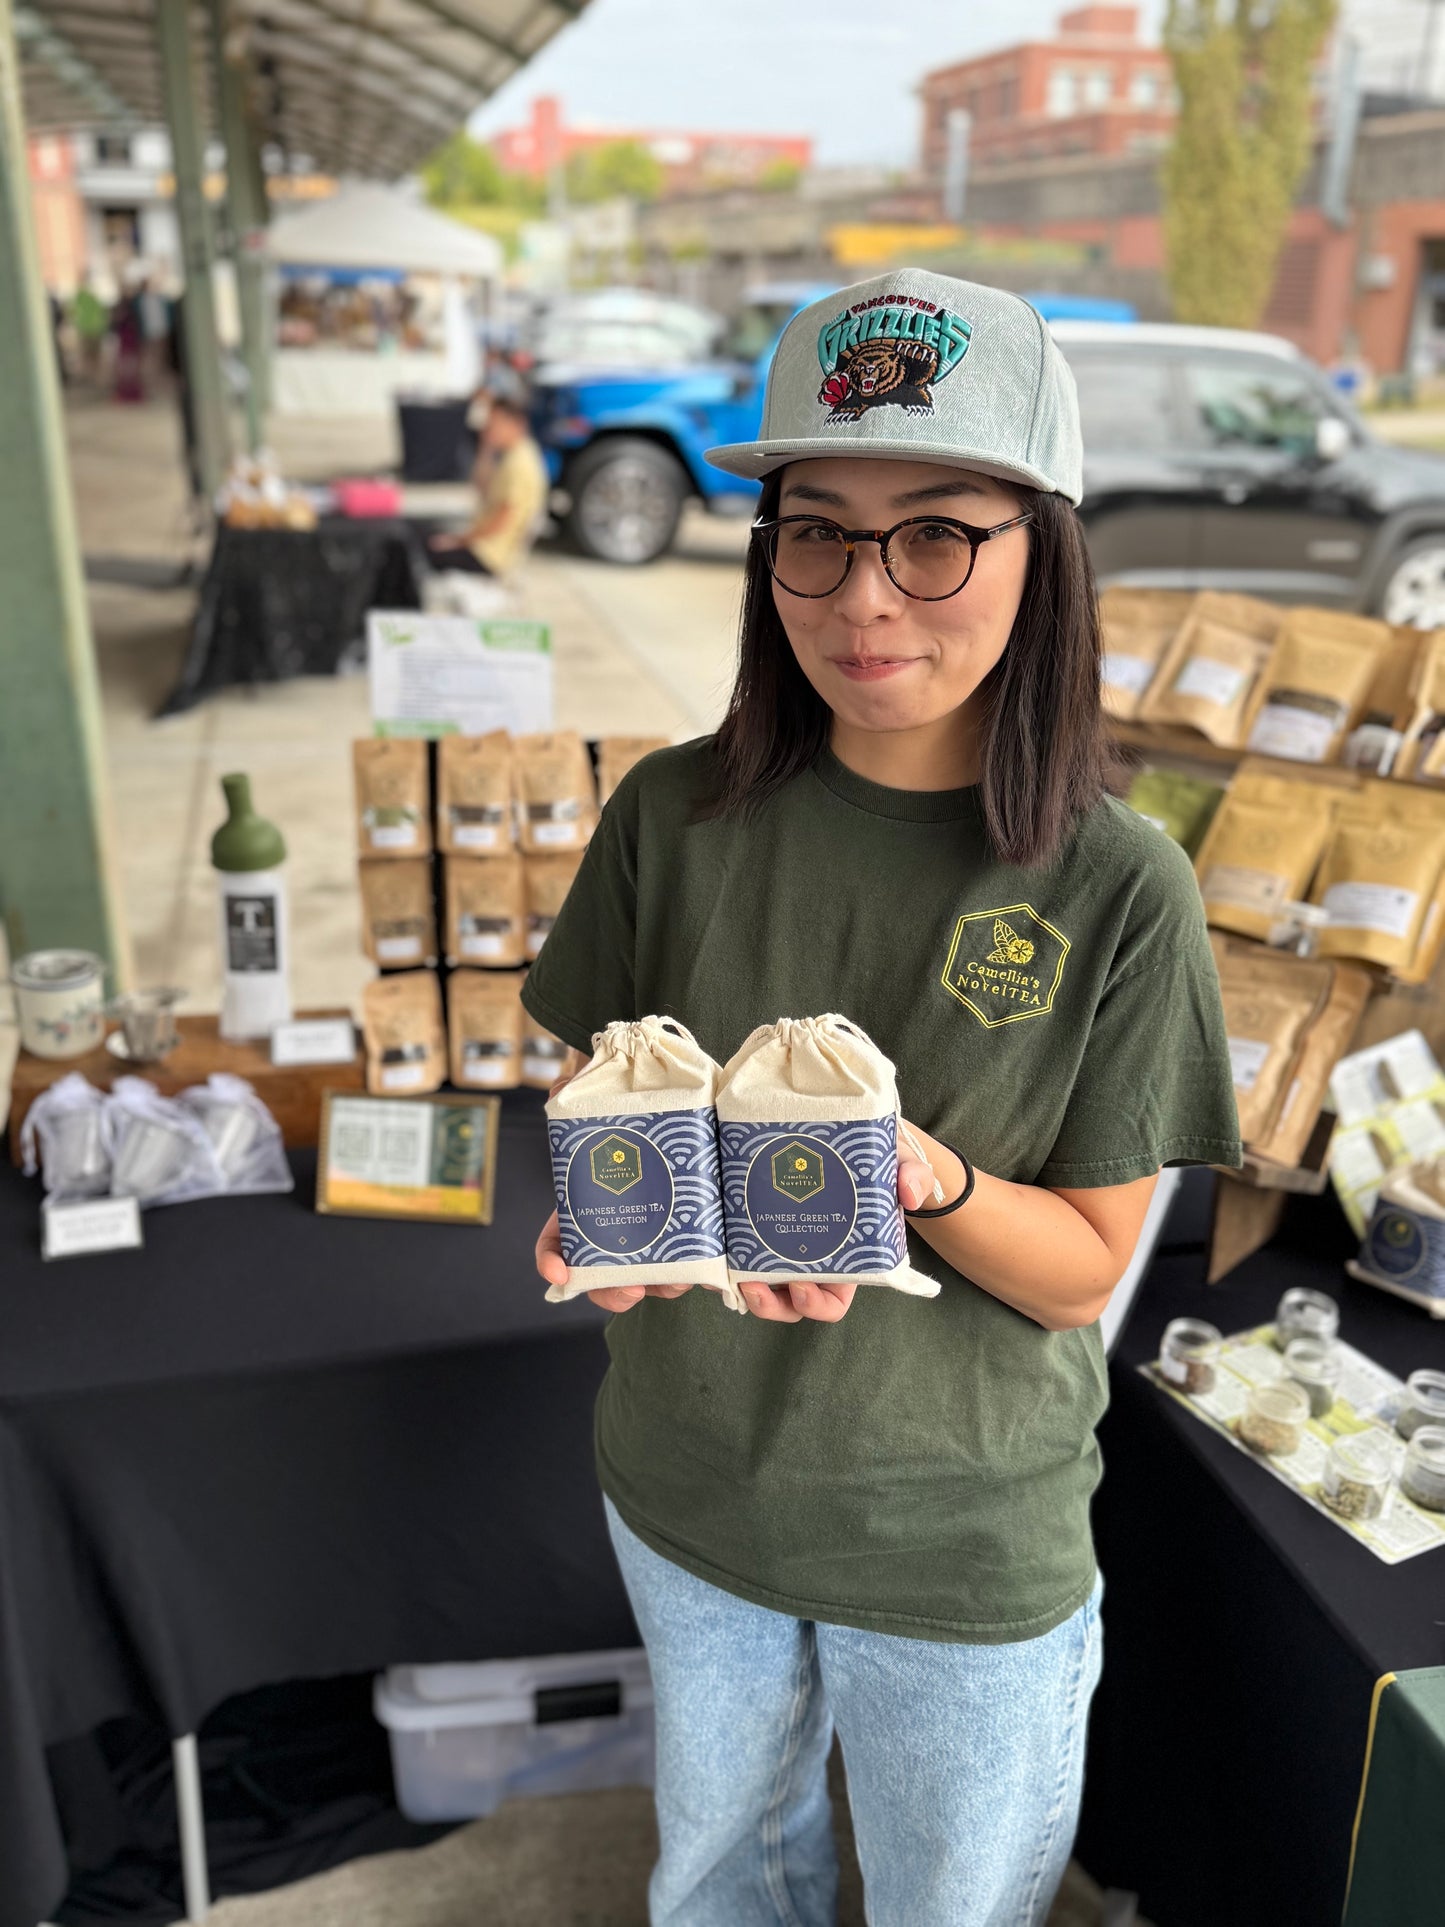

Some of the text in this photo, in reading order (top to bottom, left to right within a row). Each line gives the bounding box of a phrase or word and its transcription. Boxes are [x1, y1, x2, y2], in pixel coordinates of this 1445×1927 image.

[851, 294, 937, 315] VANCOUVER
[817, 308, 973, 384] GRIZZLIES
[967, 962, 1041, 989] Camellia's
[957, 974, 1041, 1006] NovelTEA
[599, 1172, 636, 1180] NovelTEA
[577, 1202, 665, 1218] JAPANESE GREEN TEA
[756, 1213, 847, 1223] JAPANESE GREEN TEA
[595, 1215, 648, 1227] COLLECTION
[775, 1223, 829, 1234] COLLECTION
